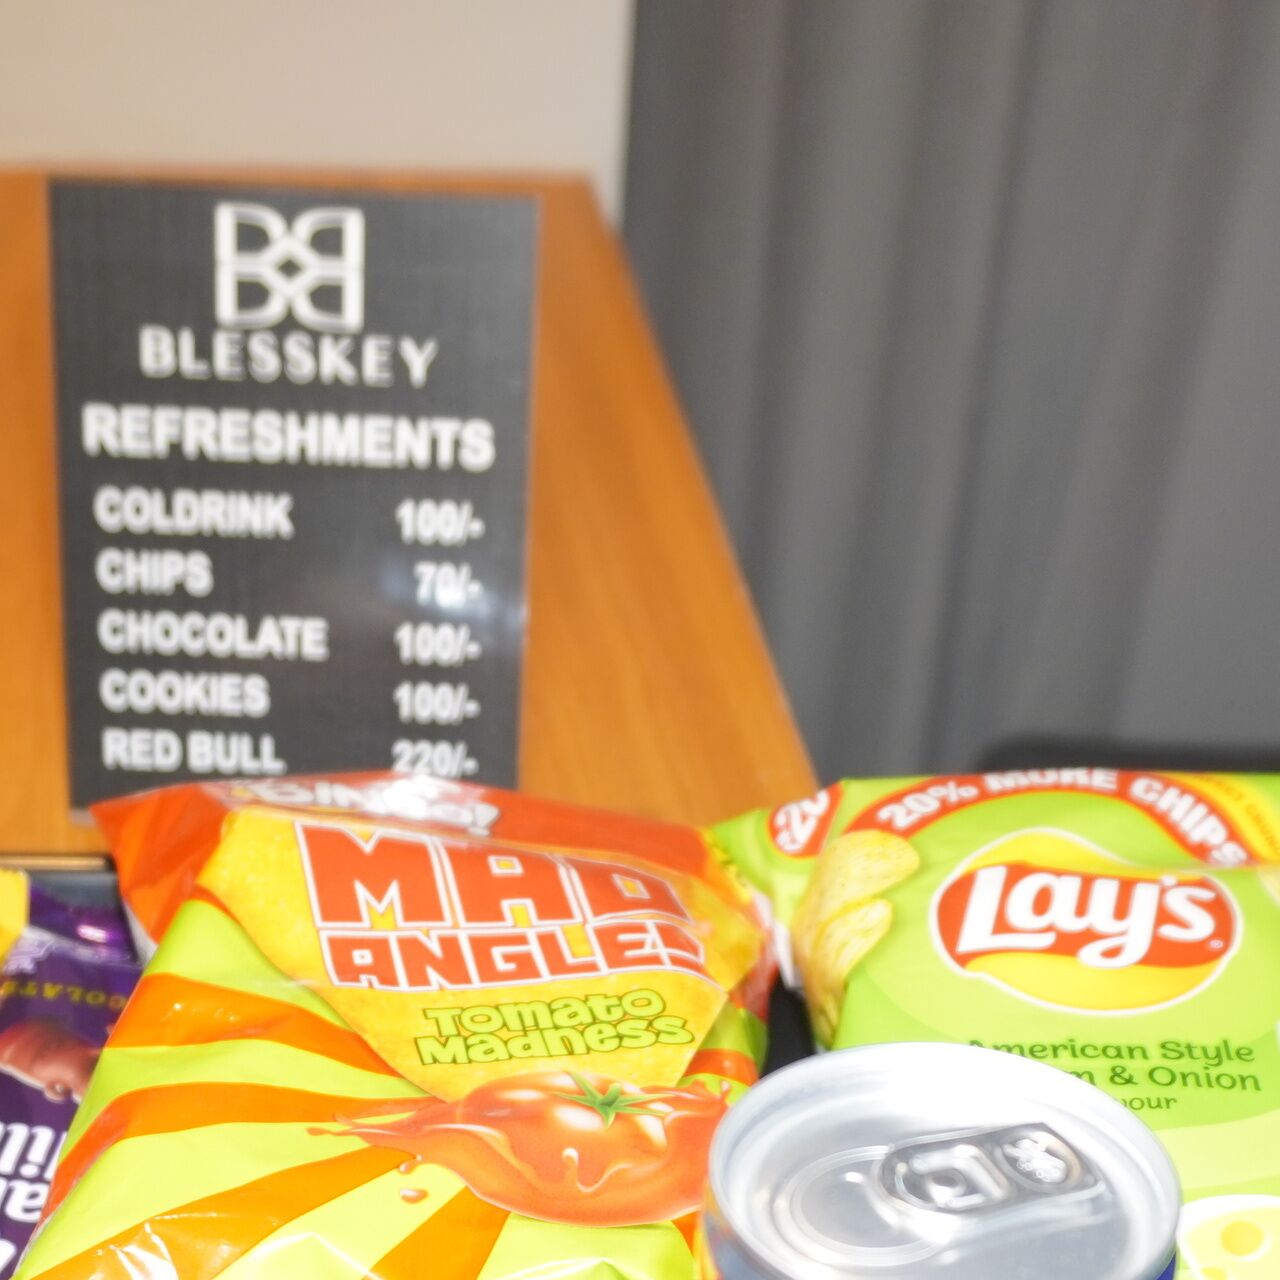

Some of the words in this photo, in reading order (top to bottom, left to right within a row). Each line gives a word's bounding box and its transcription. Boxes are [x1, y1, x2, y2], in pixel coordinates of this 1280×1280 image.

[140, 326, 437, 387] BLESSKEY
[82, 403, 495, 471] REFRESHMENTS
[94, 487, 293, 538] COLDRINK
[396, 501, 484, 543] 100/-
[96, 548, 213, 596] CHIPS
[415, 563, 482, 607] 70/-
[98, 608, 328, 662] CHOCOLATE
[395, 624, 481, 665] 100/-
[100, 669, 270, 717] COOKIES
[394, 682, 480, 724] 100/-
[102, 728, 182, 771] RED
[186, 731, 286, 773] BULL
[393, 741, 478, 778] 220/-
[875, 781, 979, 828] 20%
[1128, 776, 1248, 866] CHIPS
[294, 821, 693, 928] MAD
[956, 866, 1217, 968] Lay's
[320, 919, 706, 992] ANGLES
[423, 988, 666, 1037] Tomato
[414, 1016, 695, 1067] Madness
[1160, 1039, 1256, 1067] Style
[1148, 1065, 1262, 1092] Onion
